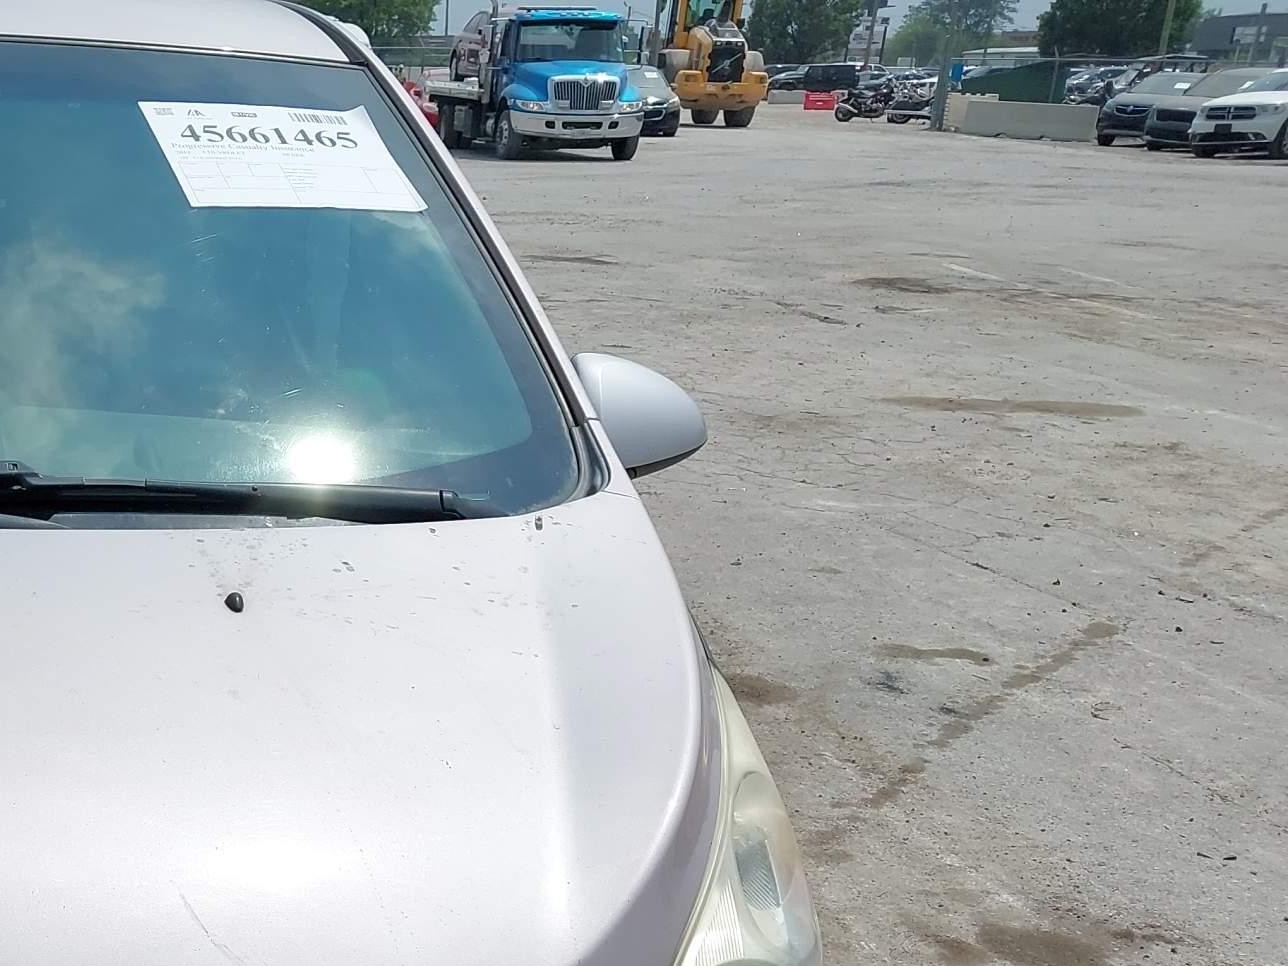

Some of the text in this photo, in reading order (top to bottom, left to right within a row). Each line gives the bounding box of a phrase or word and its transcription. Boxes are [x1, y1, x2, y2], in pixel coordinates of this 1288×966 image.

[180, 124, 358, 149] 45661465
[171, 142, 315, 153] Progressive Casualty Insurance
